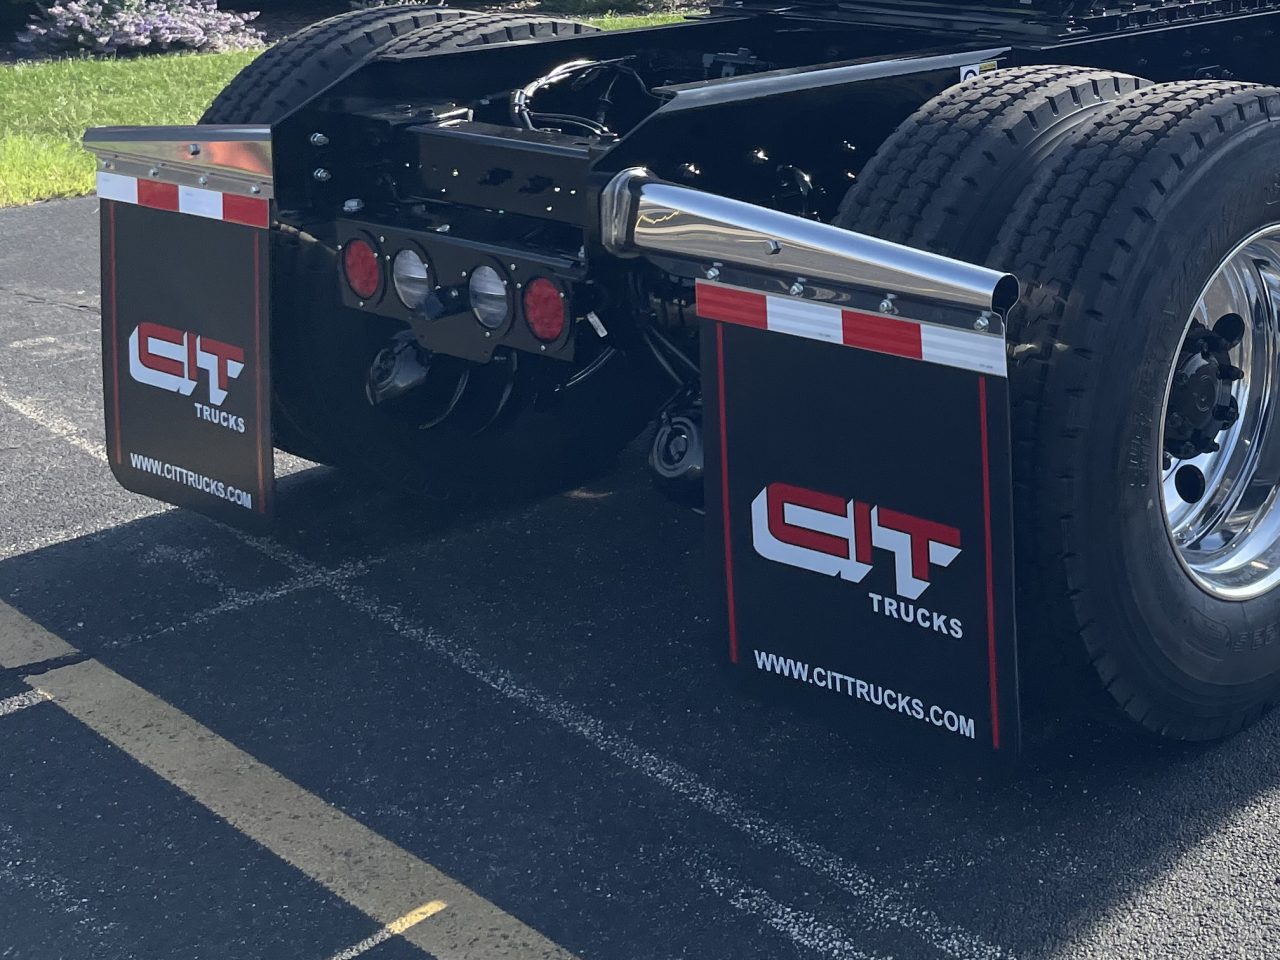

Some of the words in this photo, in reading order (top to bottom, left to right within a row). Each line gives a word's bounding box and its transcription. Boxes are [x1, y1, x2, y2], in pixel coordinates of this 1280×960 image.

[129, 322, 245, 406] CIT
[194, 402, 246, 433] TRUCKS
[130, 452, 252, 510] WWW.CITTRUCKS.COM
[751, 482, 962, 600] CIT
[868, 592, 963, 639] TRUCKS
[753, 649, 976, 739] WWW.CITTRUCKS.COM
